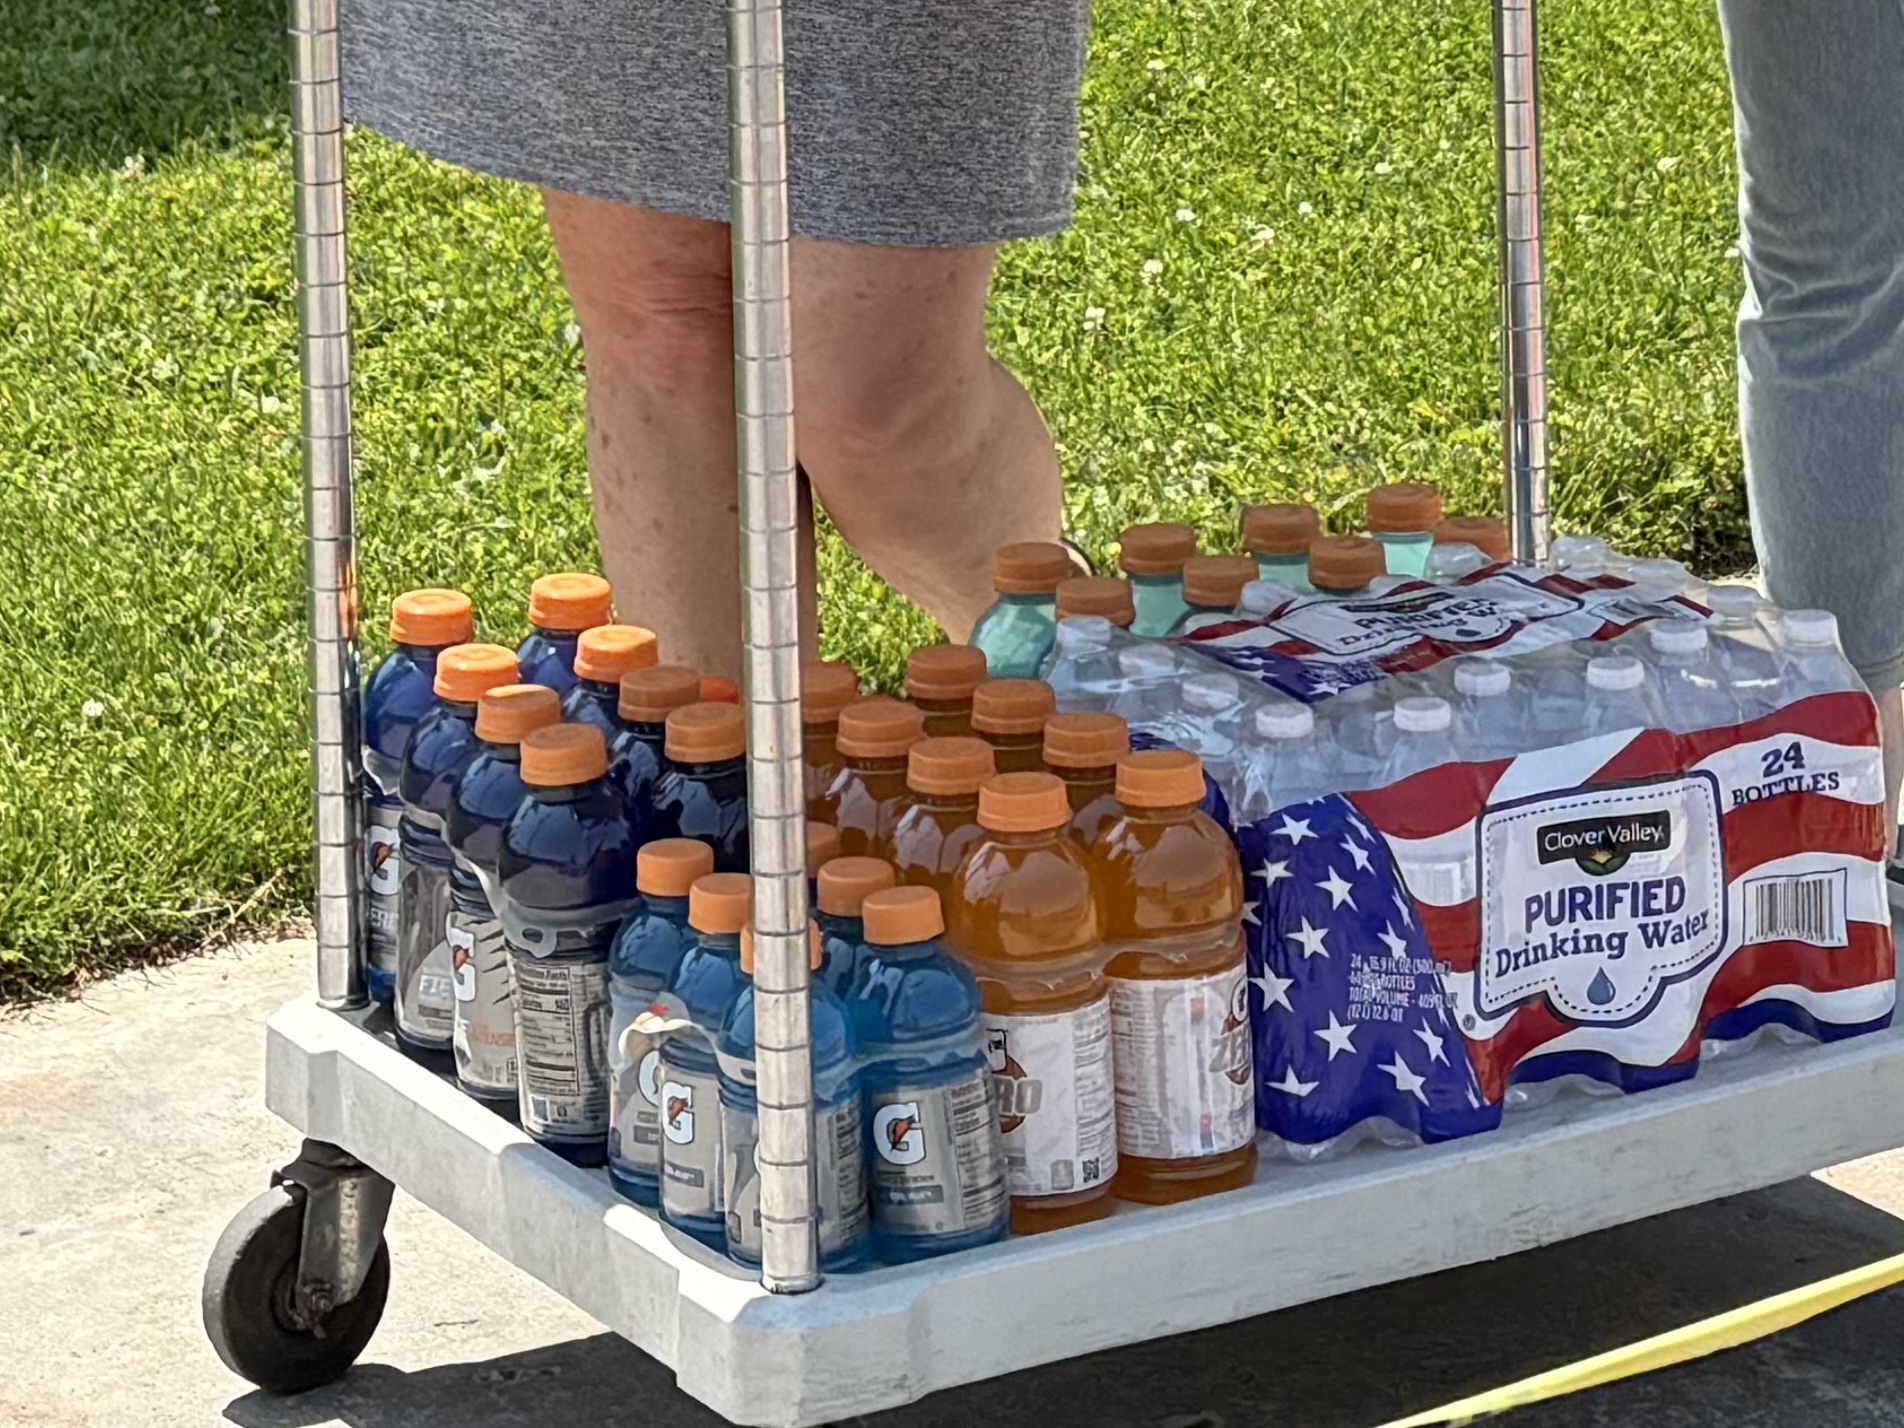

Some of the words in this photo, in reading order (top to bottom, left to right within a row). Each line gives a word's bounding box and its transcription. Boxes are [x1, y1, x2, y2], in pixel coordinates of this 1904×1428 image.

[1730, 770, 1841, 807] BOTTLES
[1760, 740, 1808, 779] 24
[1543, 828, 1606, 852] Clover
[1606, 821, 1663, 845] Valley
[1524, 875, 1686, 934] PURIFIED
[1494, 926, 1629, 980] Drinking
[1636, 908, 1710, 950] Water
[661, 1080, 695, 1145] G
[872, 1101, 927, 1166] G
